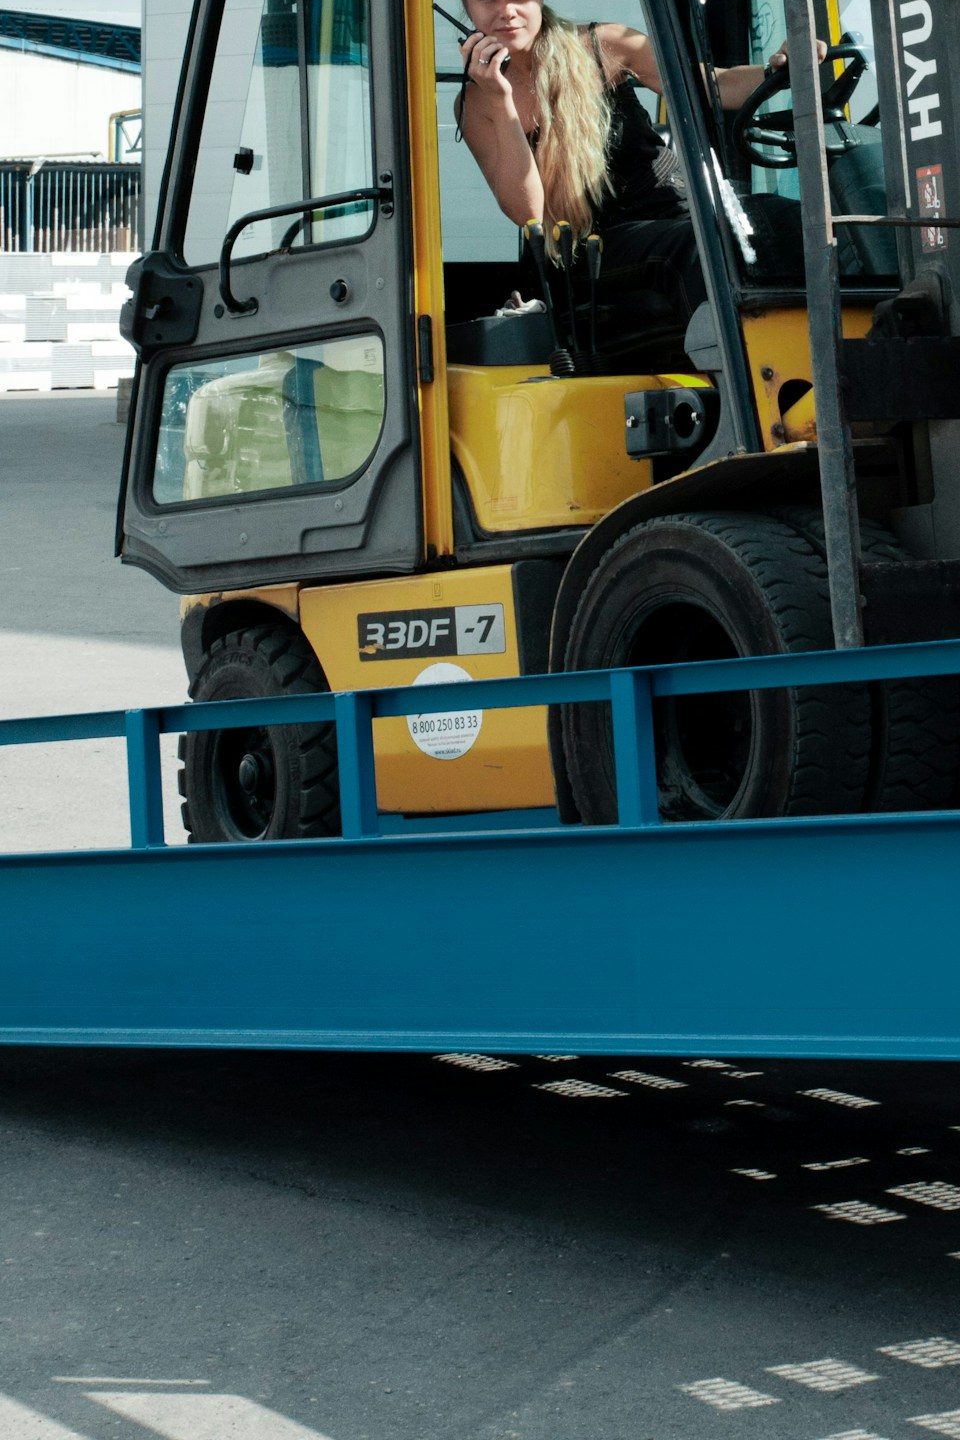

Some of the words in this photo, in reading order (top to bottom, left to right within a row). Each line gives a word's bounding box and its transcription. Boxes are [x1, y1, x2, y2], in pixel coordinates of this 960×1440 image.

[412, 721, 418, 734] 8
[420, 720, 435, 733] 800
[437, 718, 453, 732] 250
[454, 716, 465, 730] 83
[467, 715, 478, 729] 33
